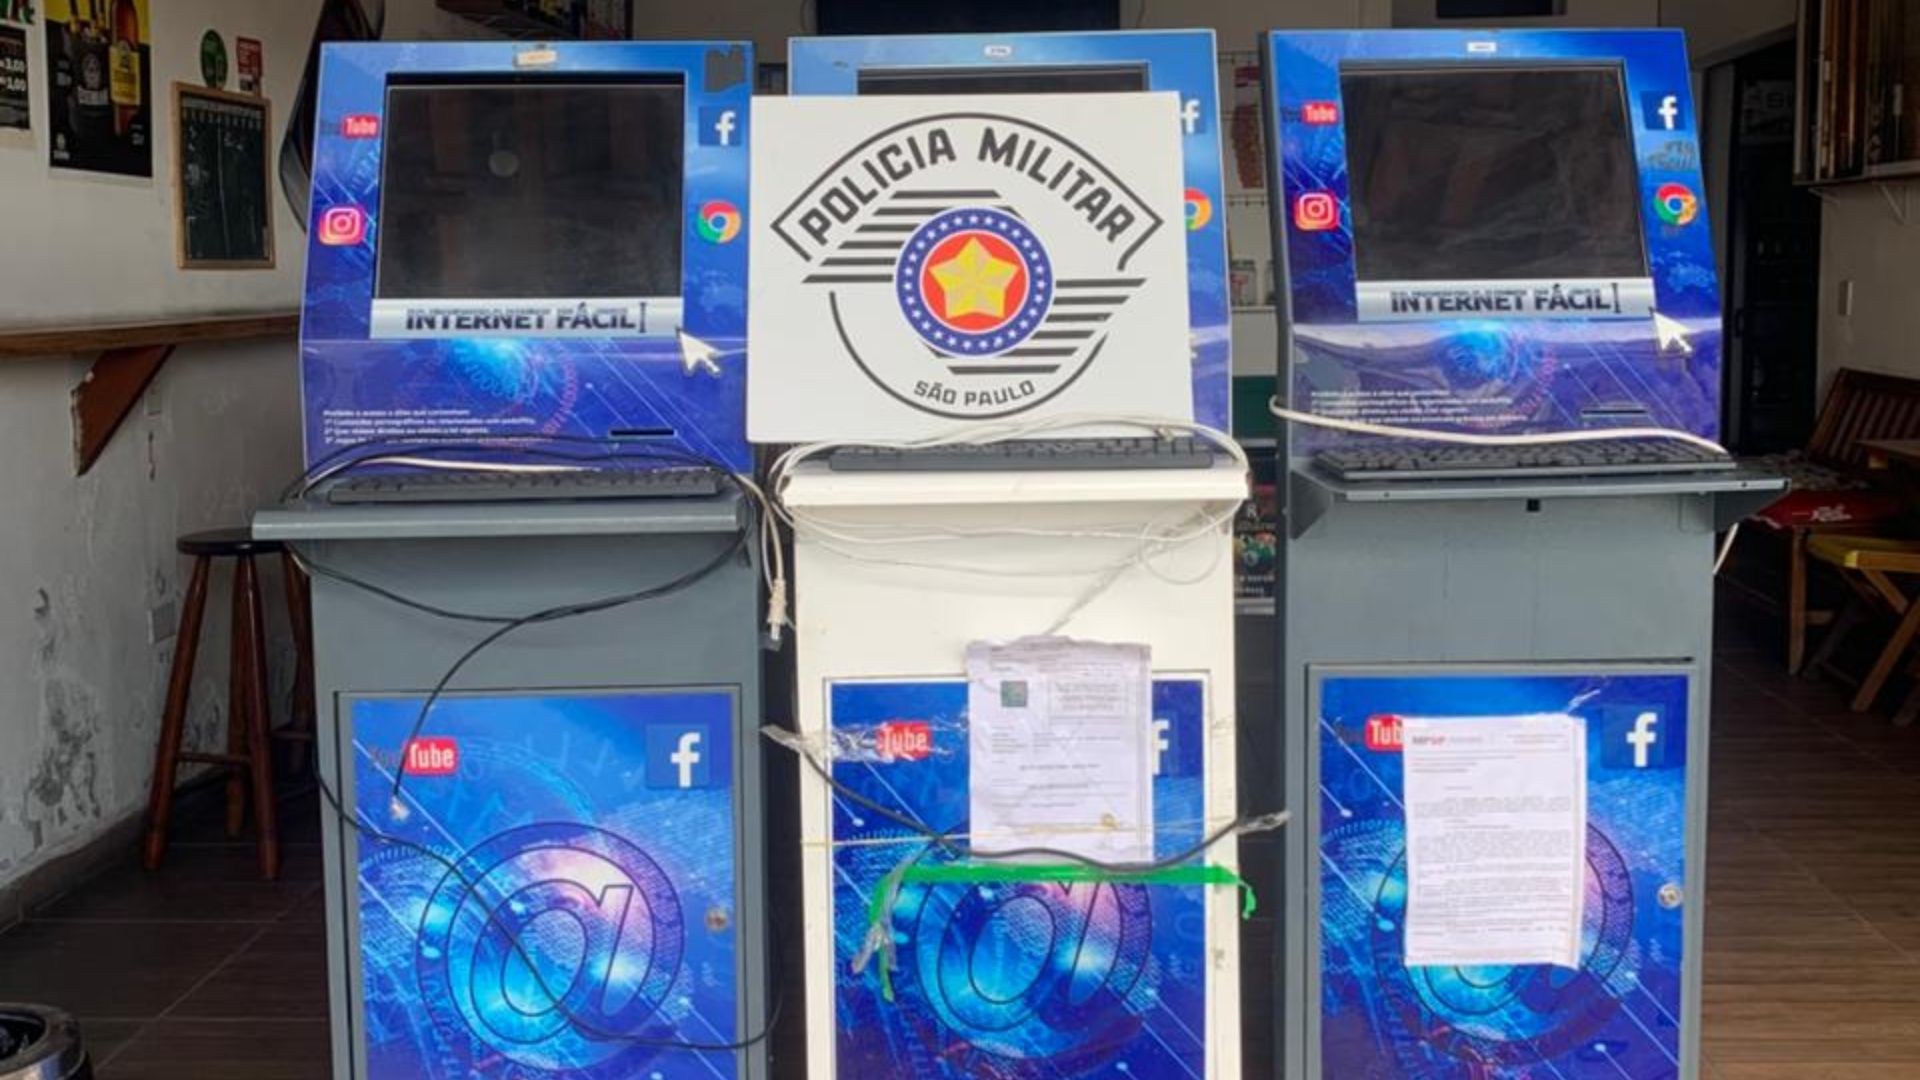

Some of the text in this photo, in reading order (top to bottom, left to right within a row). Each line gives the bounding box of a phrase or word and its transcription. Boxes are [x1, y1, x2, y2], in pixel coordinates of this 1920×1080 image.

[798, 126, 1136, 246] POLICIA MILITAR
[1391, 283, 1611, 313] INTERNET FÁCIL
[405, 301, 636, 330] INTERNET FÁCIL
[914, 379, 1035, 406] SÃO PAULO
